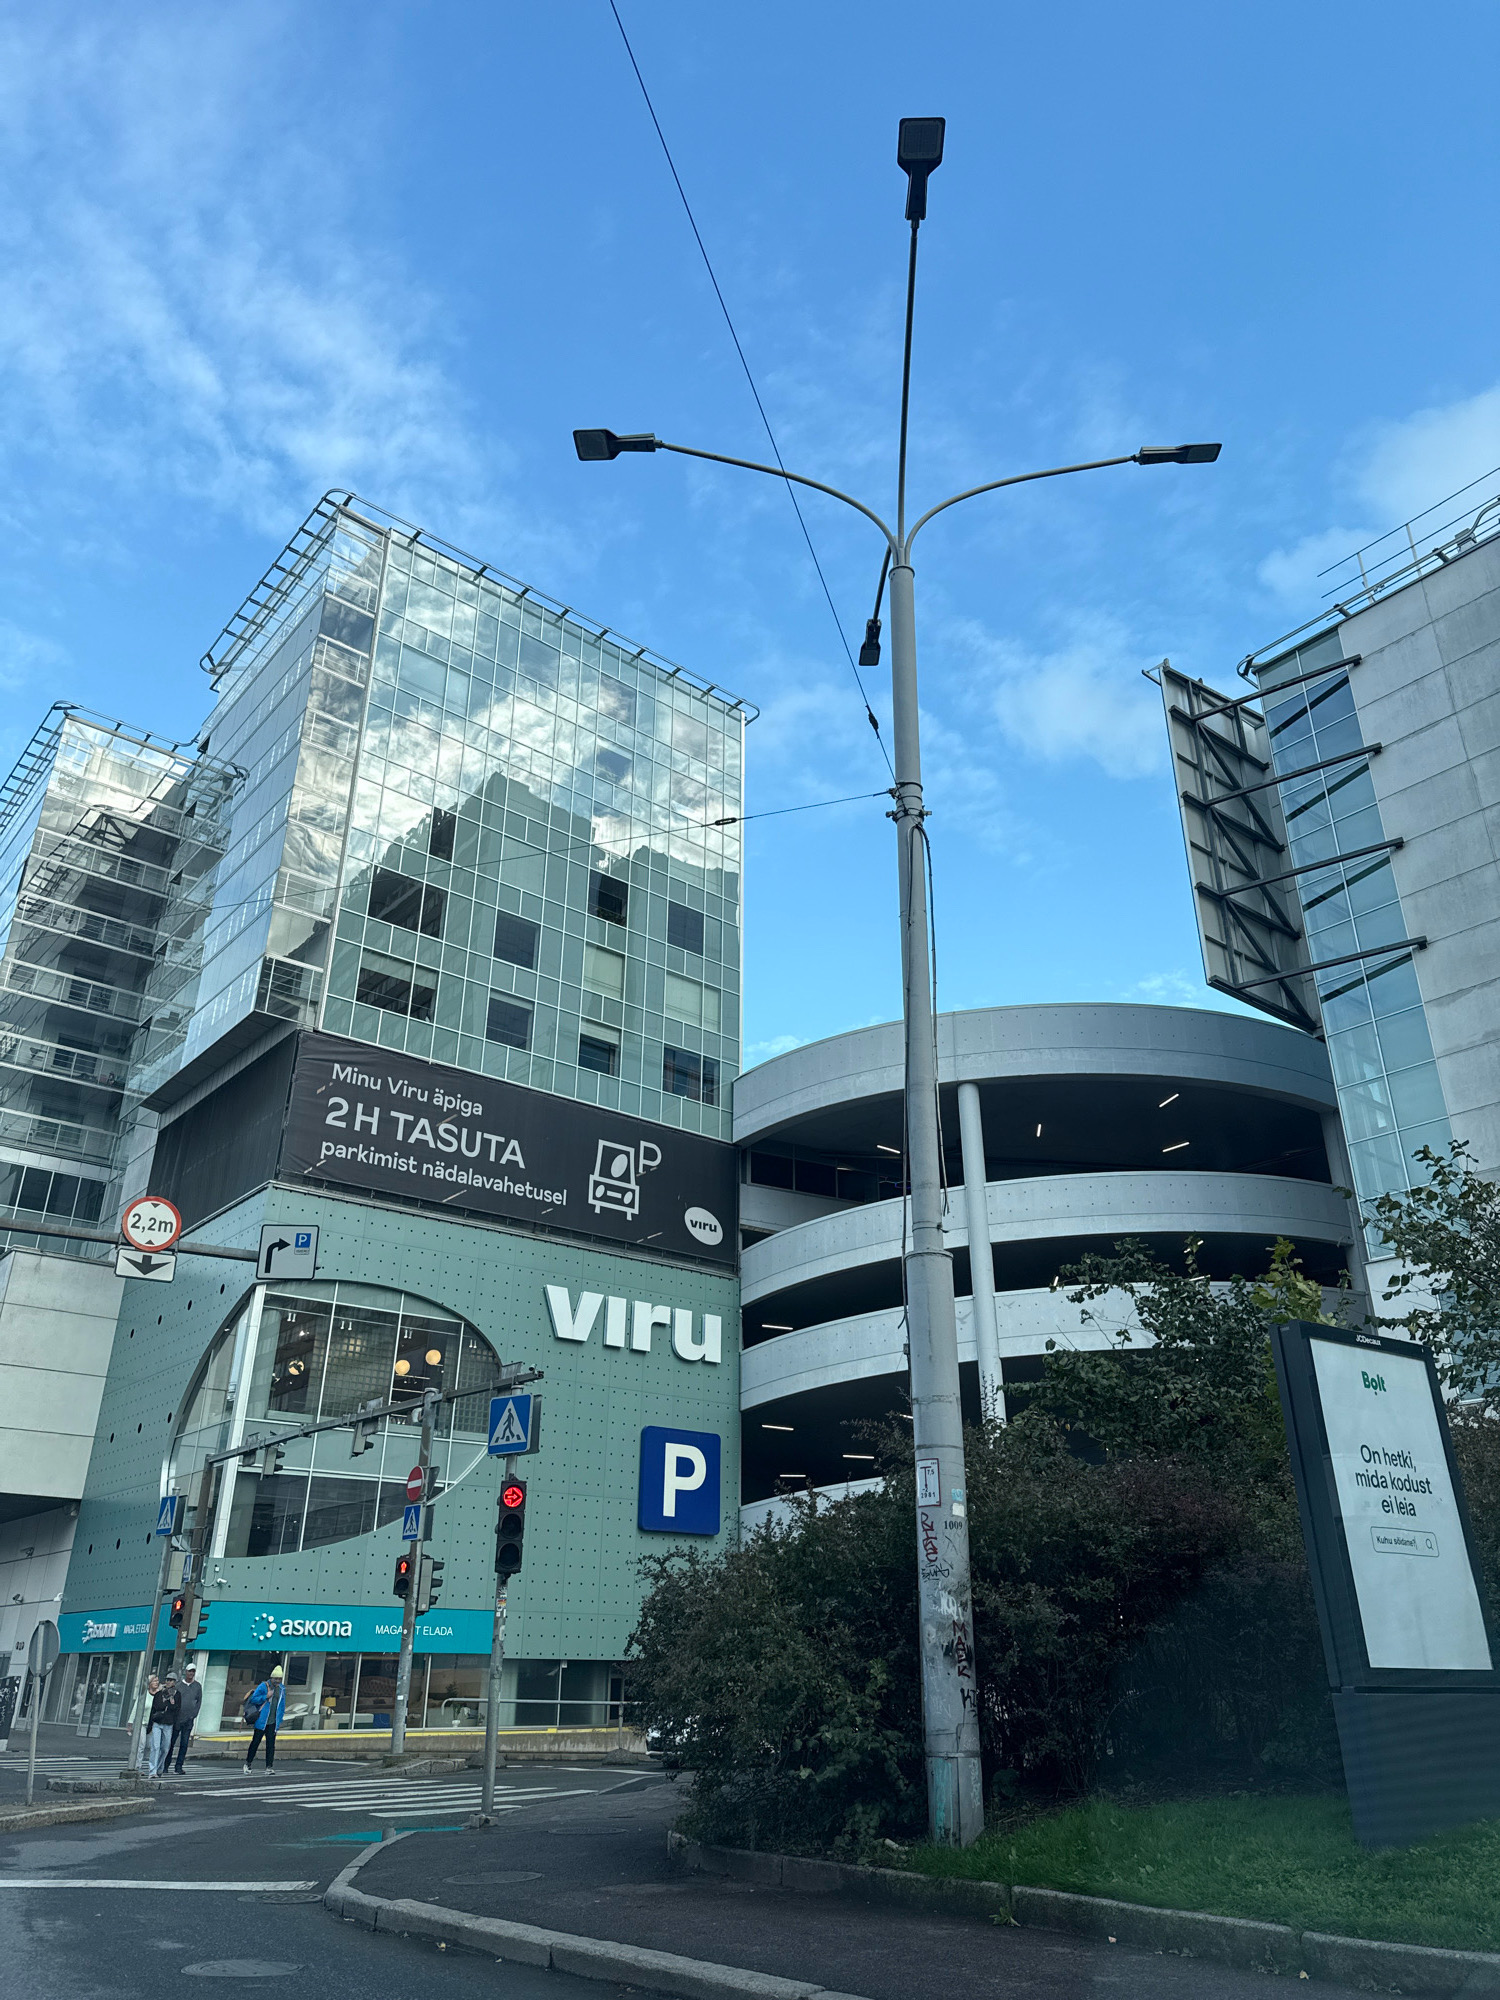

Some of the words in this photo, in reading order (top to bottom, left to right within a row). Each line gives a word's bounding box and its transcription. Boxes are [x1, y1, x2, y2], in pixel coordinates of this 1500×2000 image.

[331, 1062, 381, 1091] Minu
[388, 1076, 429, 1101] Viru
[433, 1086, 483, 1117] äpiga
[390, 1109, 526, 1169] TASUTA
[638, 1140, 662, 1174] P
[320, 1139, 418, 1173] parkimist
[422, 1161, 567, 1206] nädalavahetusel
[298, 1234, 308, 1247] P
[1355, 1334, 1382, 1347] JCDecaux
[1360, 1370, 1387, 1396] Bolt
[1360, 1444, 1381, 1464] On
[1382, 1446, 1417, 1473] hetki,
[662, 1442, 707, 1518] P
[1355, 1471, 1388, 1489] mida
[1389, 1473, 1433, 1495] kodust
[1381, 1496, 1395, 1514] ei
[1395, 1496, 1417, 1517] leia
[944, 1520, 963, 1530] 1009
[280, 1618, 352, 1638] askona
[375, 1624, 403, 1635] MAGA
[422, 1626, 454, 1636] ELADA
